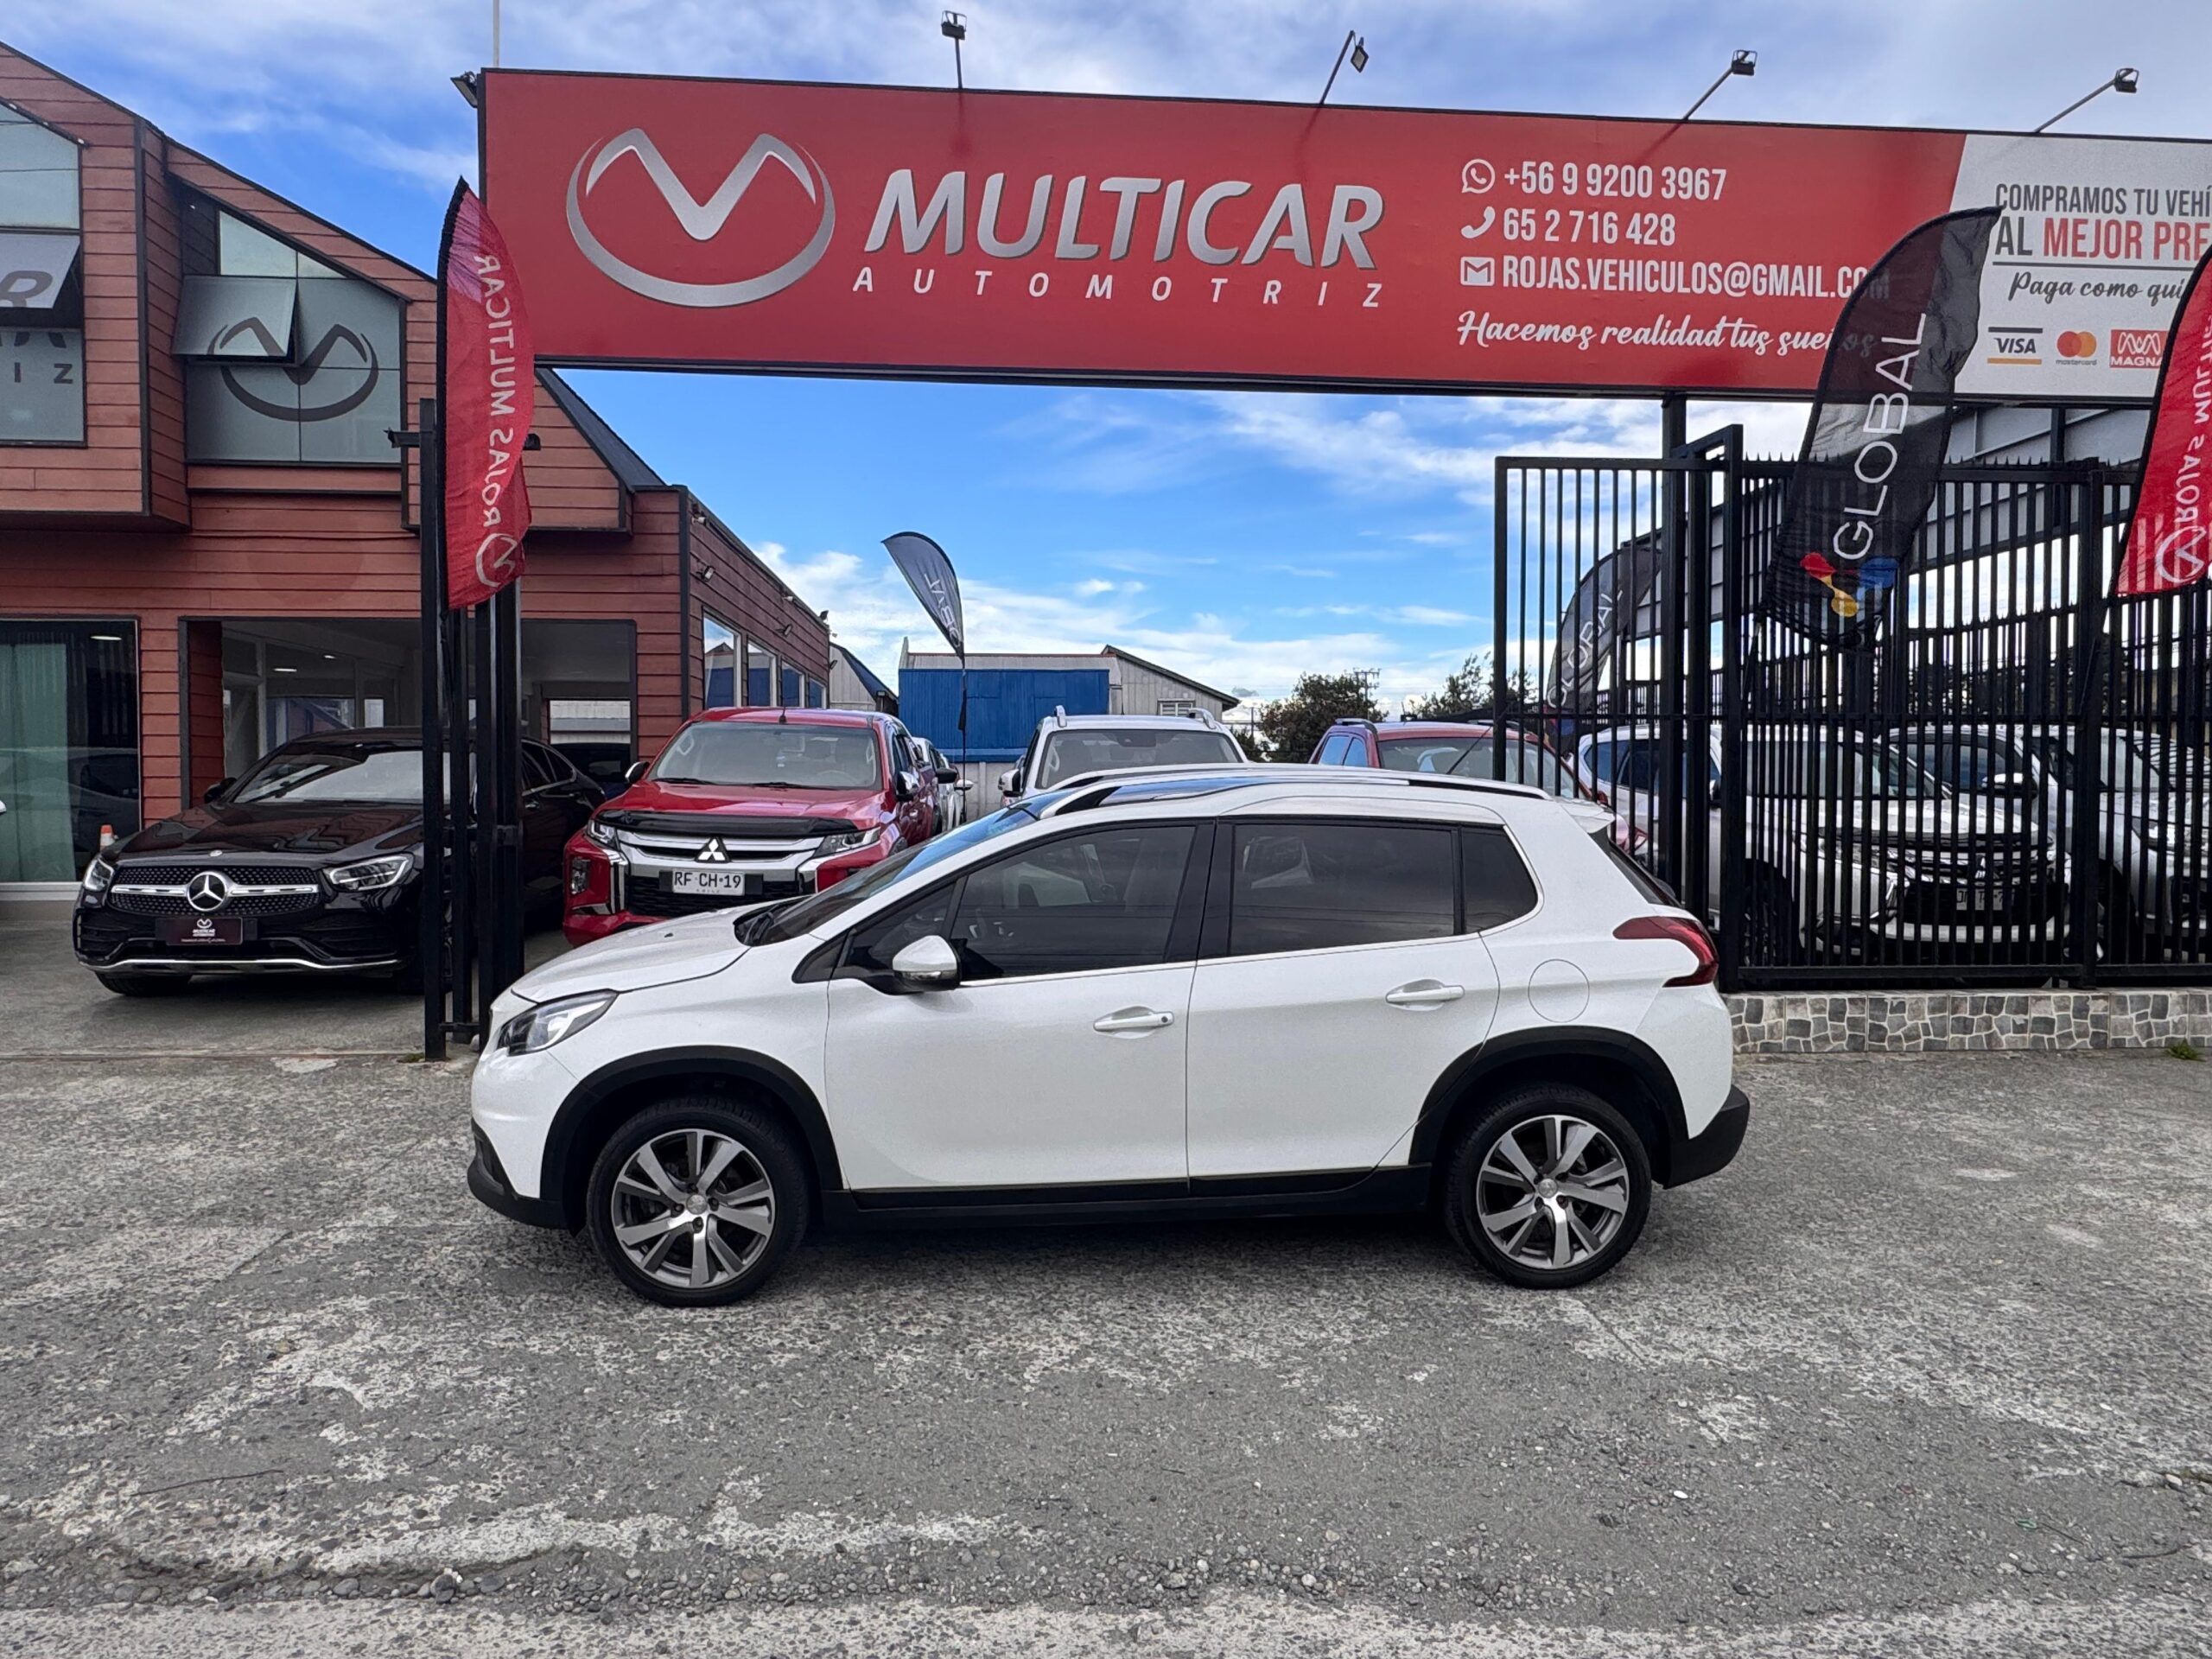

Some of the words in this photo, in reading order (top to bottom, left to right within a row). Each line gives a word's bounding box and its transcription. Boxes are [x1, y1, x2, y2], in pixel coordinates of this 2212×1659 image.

[1504, 161, 1554, 194] +56
[1562, 162, 1578, 195] 9
[1586, 163, 1653, 198] 9200
[1661, 167, 1727, 200] 3967
[1995, 183, 2127, 214] COMPRAMOS
[2133, 188, 2159, 215] TU
[865, 168, 1384, 270] MULTICAR
[1503, 207, 1535, 241] 65
[1544, 209, 1560, 242] 2
[1569, 210, 1618, 244] 716
[1625, 212, 1676, 246] 428
[1994, 216, 2033, 256] AL
[2043, 218, 2143, 259] MEJOR
[853, 266, 1382, 308] AUTOMOTRIZ
[2008, 271, 2076, 304] Paga
[2080, 281, 2145, 299] como
[1457, 310, 1597, 351] Hacemos
[1600, 314, 1728, 347] realidad
[1728, 316, 1774, 356] tus
[1777, 328, 1874, 358] sueos
[1993, 338, 2037, 354] VISA
[1833, 313, 1927, 560] GLOBAL
